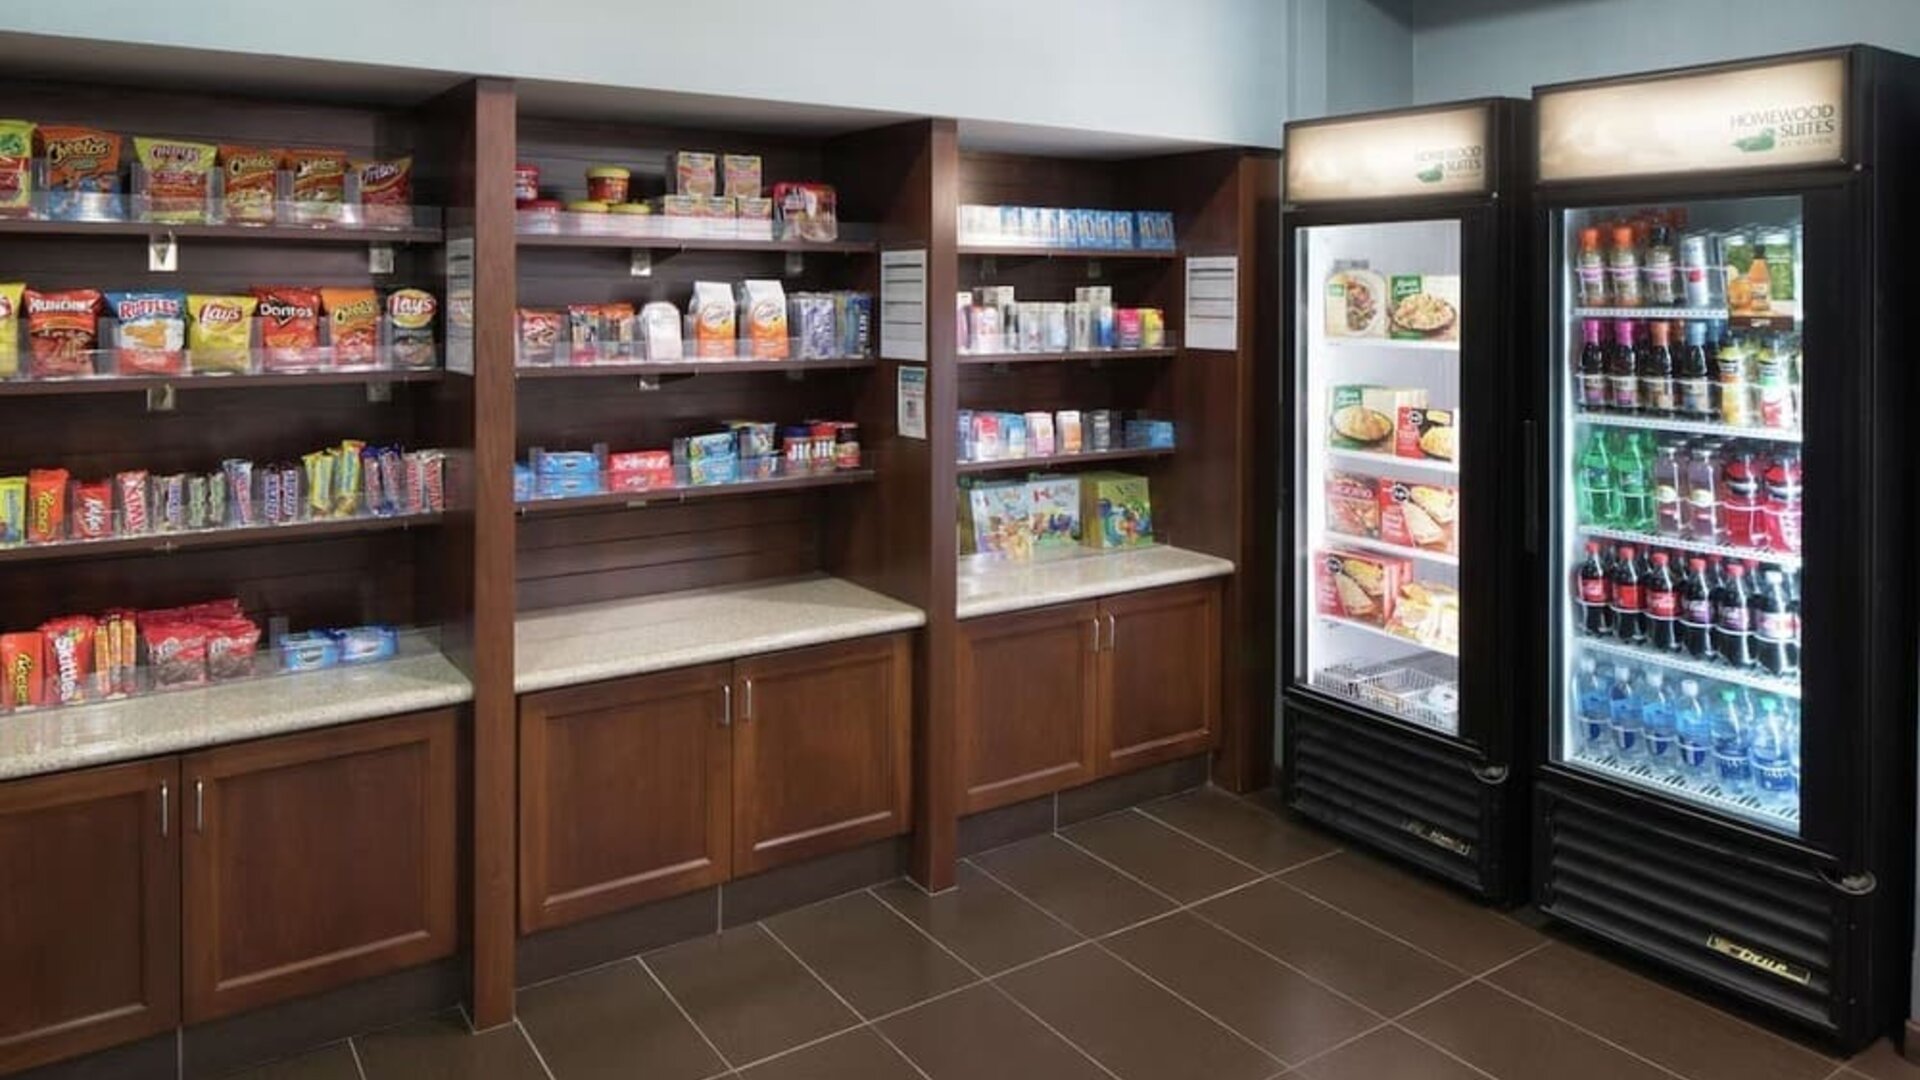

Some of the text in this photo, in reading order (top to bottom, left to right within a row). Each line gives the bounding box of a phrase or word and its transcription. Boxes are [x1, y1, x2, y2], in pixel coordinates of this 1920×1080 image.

[1729, 104, 1834, 128] HOMEWOOD
[1780, 119, 1835, 137] SUITES
[48, 138, 111, 167] Cheetos
[260, 302, 314, 319] Doritos
